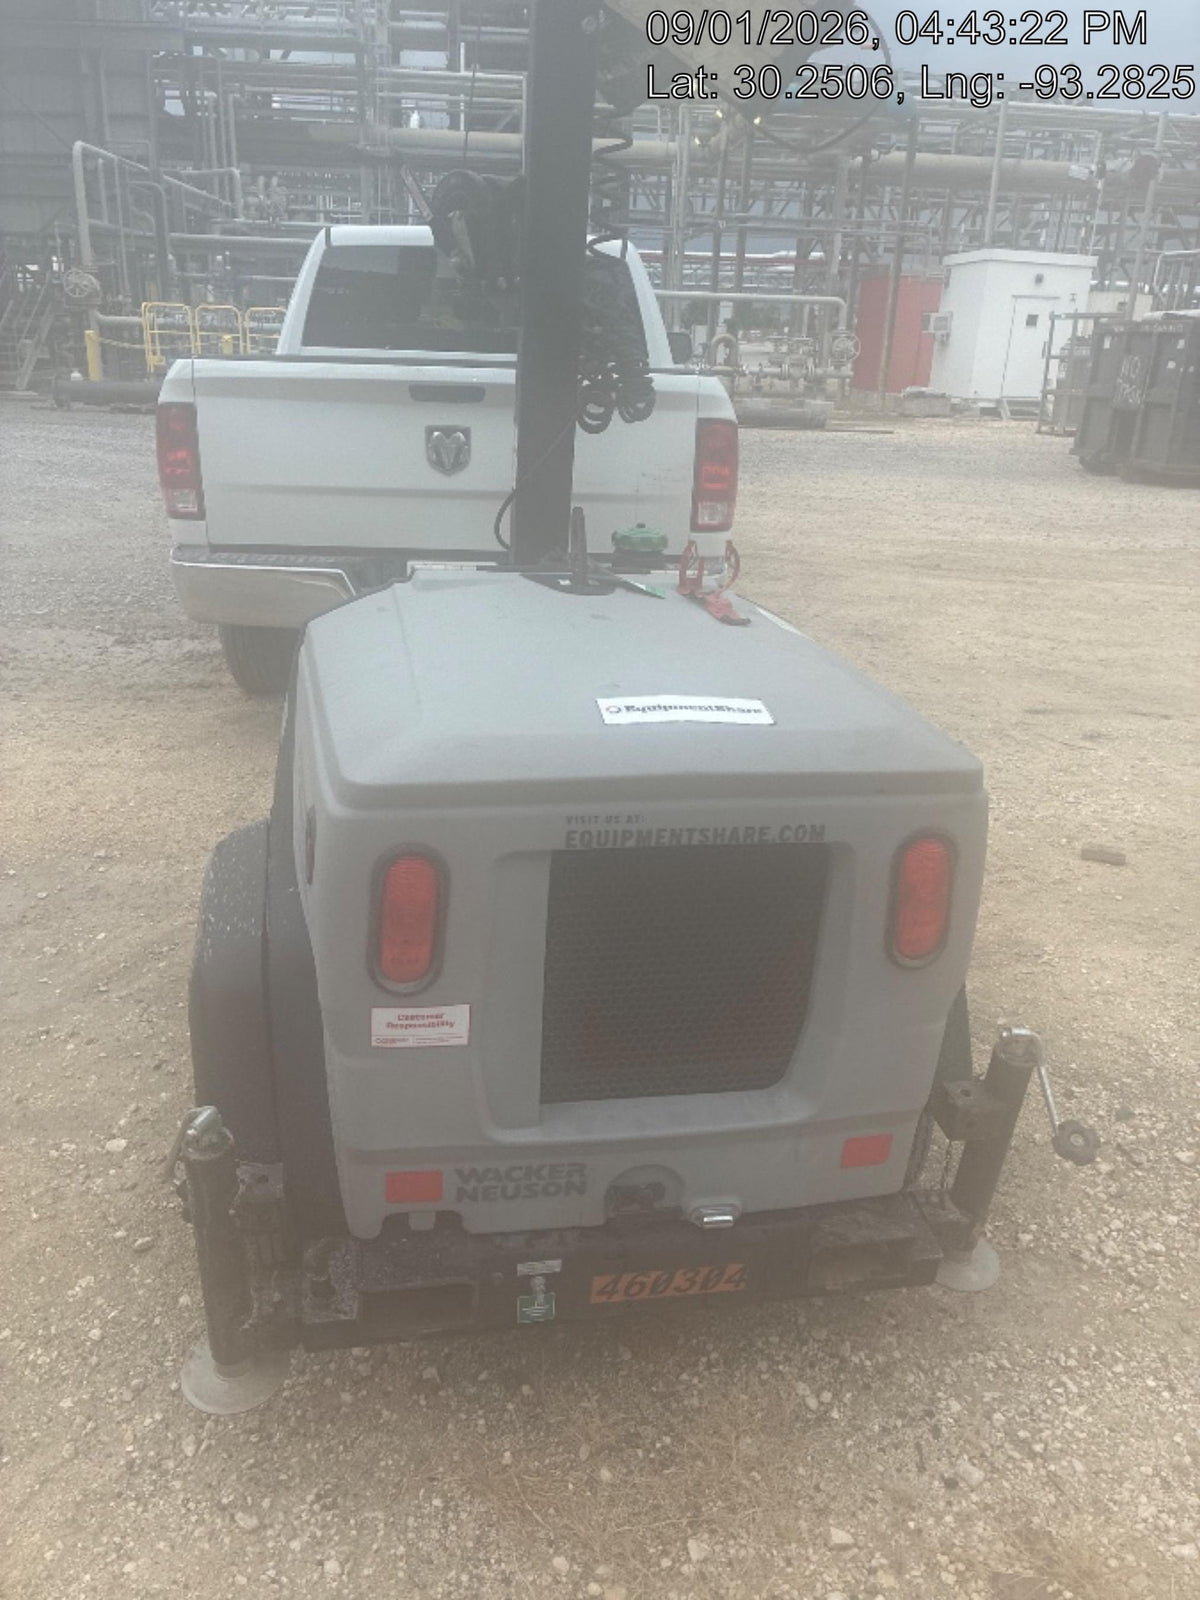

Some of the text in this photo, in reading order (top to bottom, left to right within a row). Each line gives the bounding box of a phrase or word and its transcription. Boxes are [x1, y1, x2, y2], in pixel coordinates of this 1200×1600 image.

[565, 815, 599, 825] VISIT
[604, 814, 622, 824] US
[565, 825, 826, 848] EQUIPMENTSHARE.COM
[455, 1162, 587, 1183] WACKER
[456, 1180, 587, 1202] NEUSON
[596, 1265, 745, 1300] 460304
